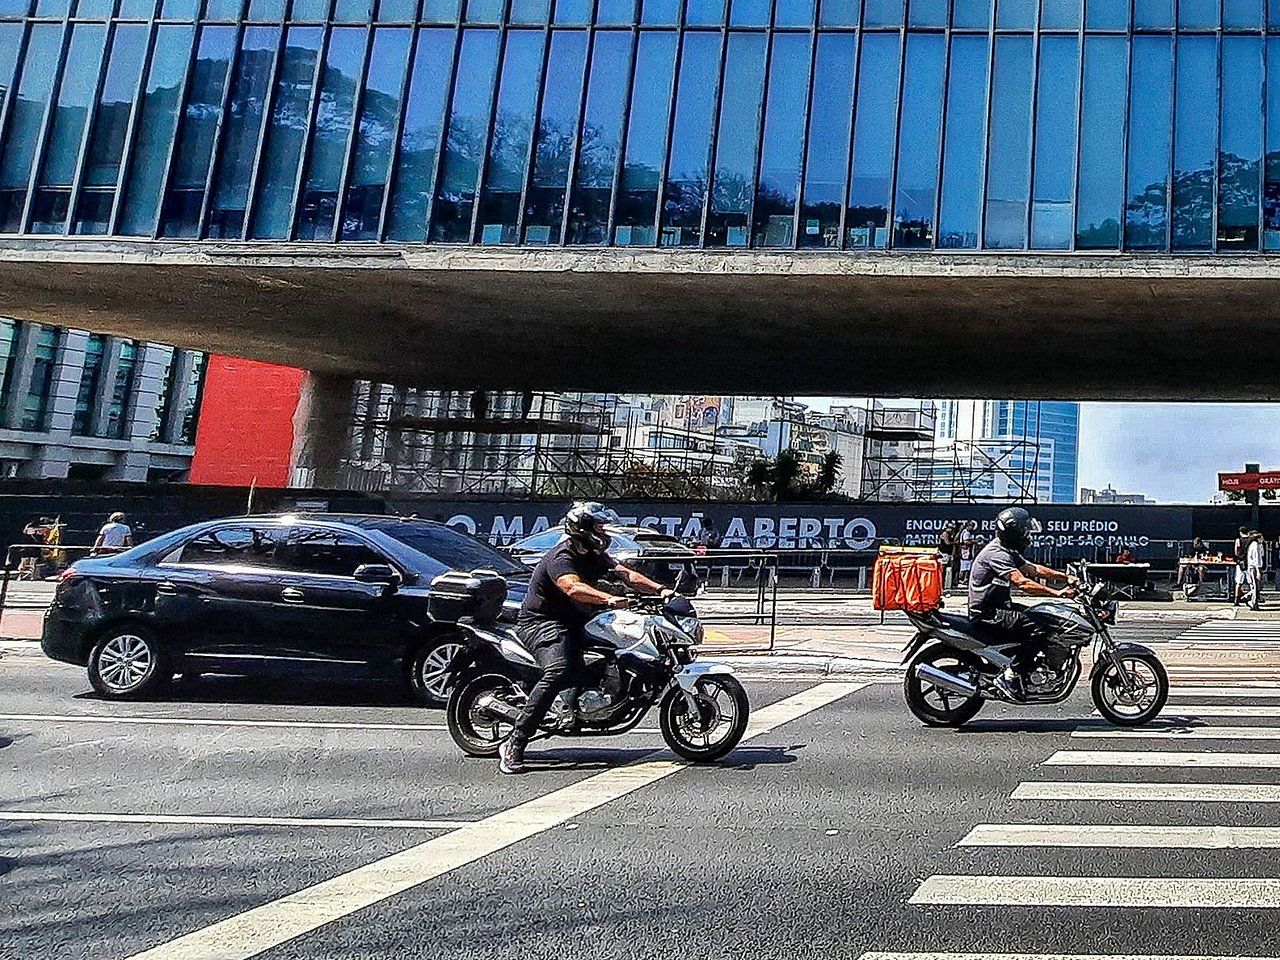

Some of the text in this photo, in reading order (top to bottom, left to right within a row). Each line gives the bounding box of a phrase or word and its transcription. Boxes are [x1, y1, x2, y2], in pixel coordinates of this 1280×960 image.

[719, 517, 876, 550] ABERTO
[1046, 520, 1069, 532] SEU
[1073, 519, 1119, 532] PRÉDIO
